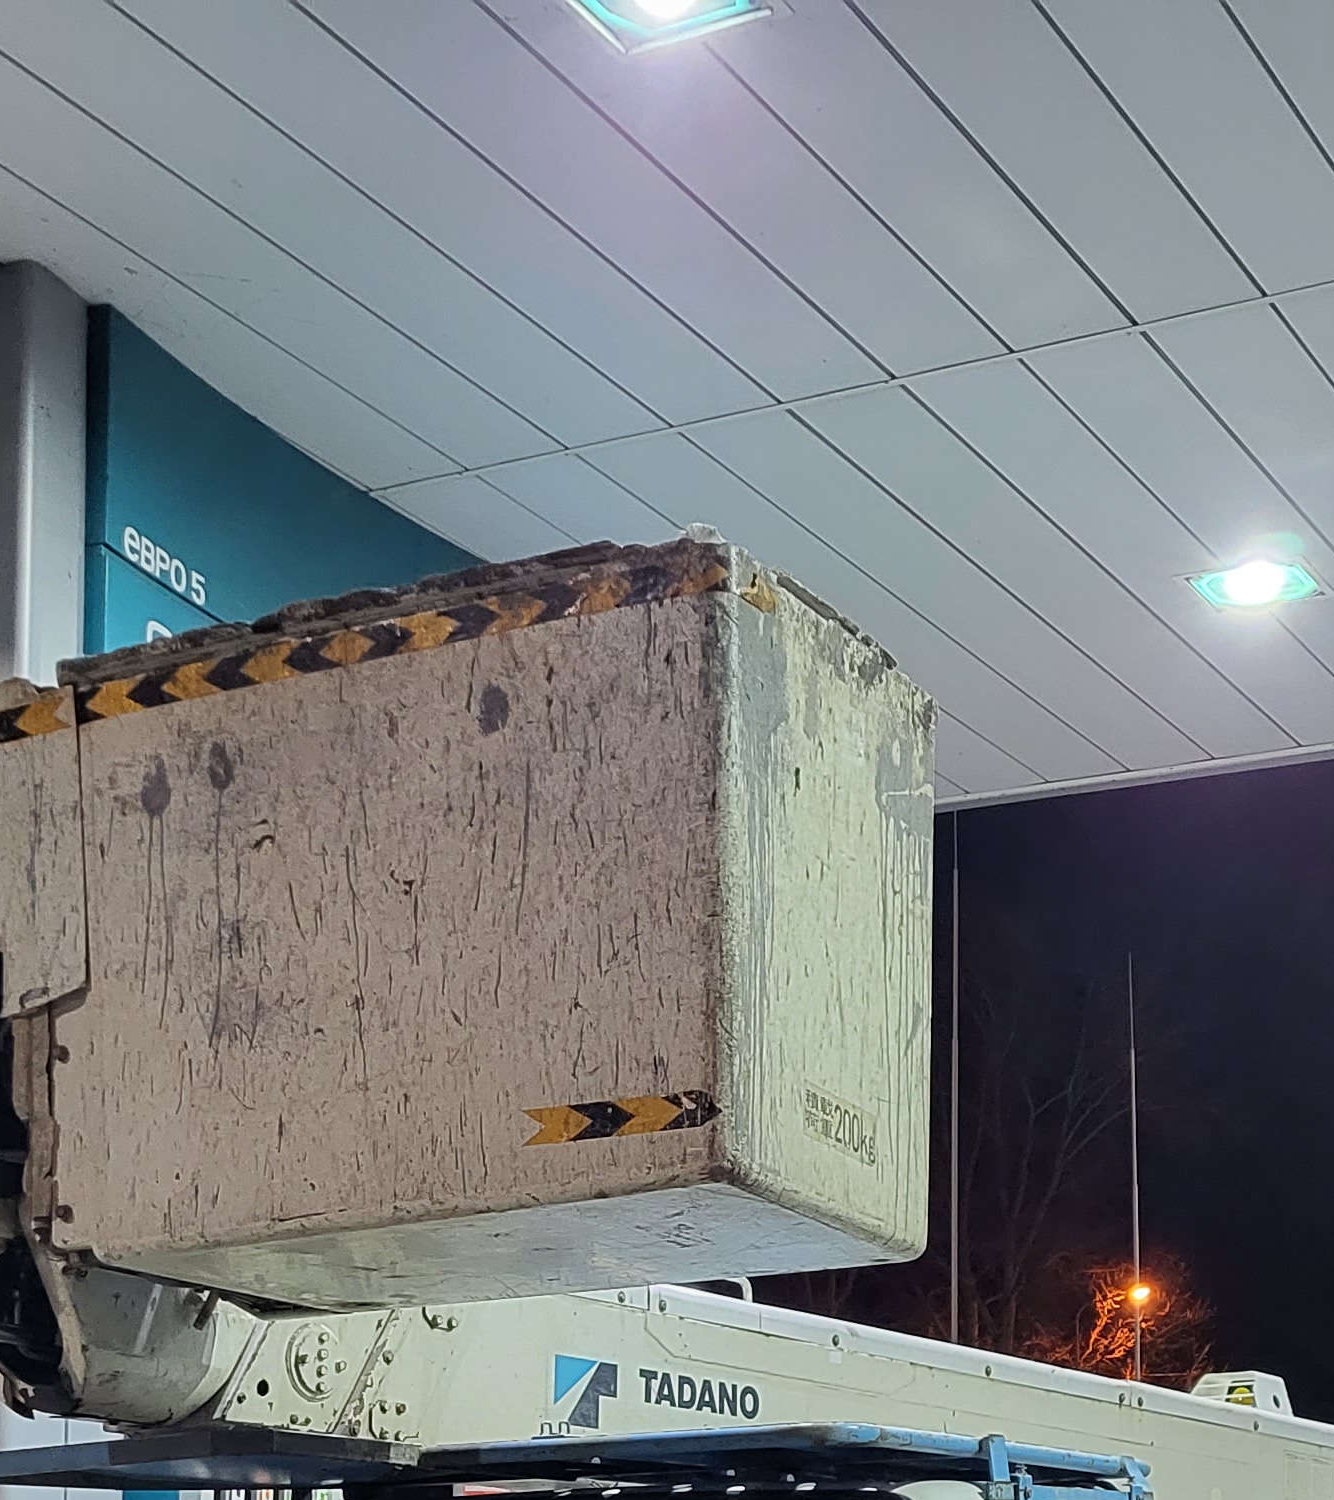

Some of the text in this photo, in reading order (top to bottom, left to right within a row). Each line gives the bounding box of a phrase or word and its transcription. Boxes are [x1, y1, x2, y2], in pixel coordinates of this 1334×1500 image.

[191, 569, 205, 606] 5
[834, 1103, 876, 1165] 200kg
[639, 1368, 759, 1420] TADANO
